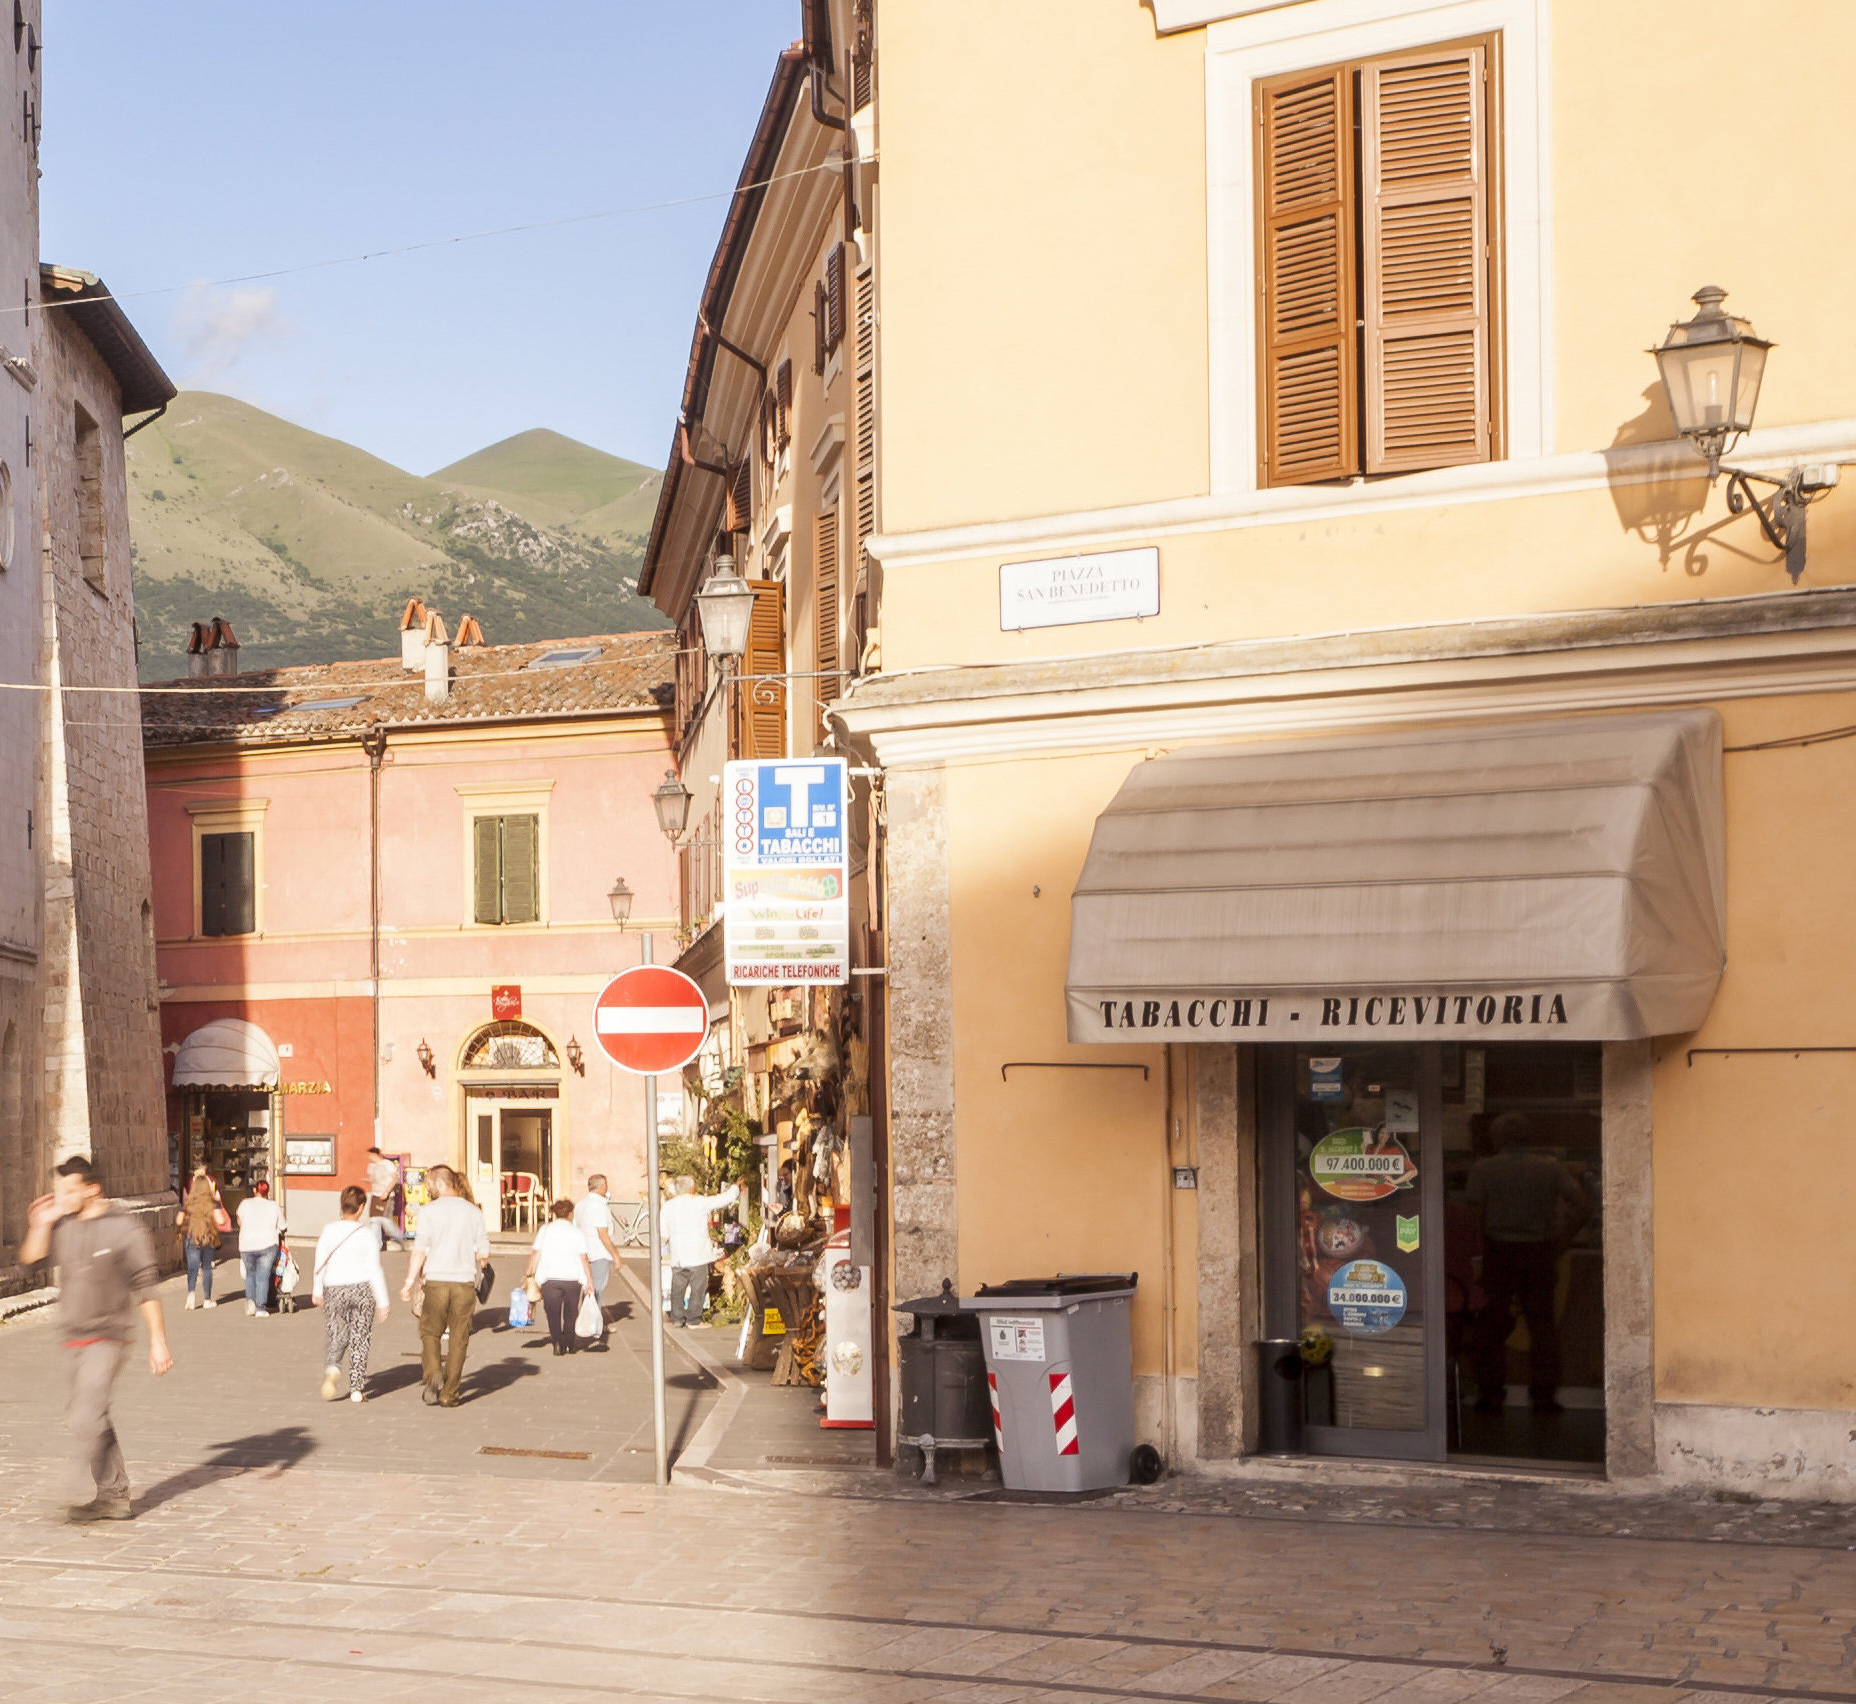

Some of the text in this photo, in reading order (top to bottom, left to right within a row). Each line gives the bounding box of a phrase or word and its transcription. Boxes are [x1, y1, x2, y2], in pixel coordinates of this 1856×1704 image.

[1052, 566, 1103, 583] PIAZZA
[1017, 587, 1044, 600] SAN
[1049, 578, 1140, 598] BENEDETTO
[775, 766, 825, 827] T
[785, 827, 815, 838] SALI E
[761, 838, 840, 854] TABACCHI
[733, 964, 841, 978] RICARICHE TELEFONICHE
[1100, 998, 1270, 1027] TABACCHI
[1320, 994, 1568, 1026] RICEVITORIA
[278, 1081, 332, 1095] MARZIA
[1327, 1158, 1400, 1171] 97.400.000 €
[1333, 1292, 1401, 1304] 34.000.000 €
